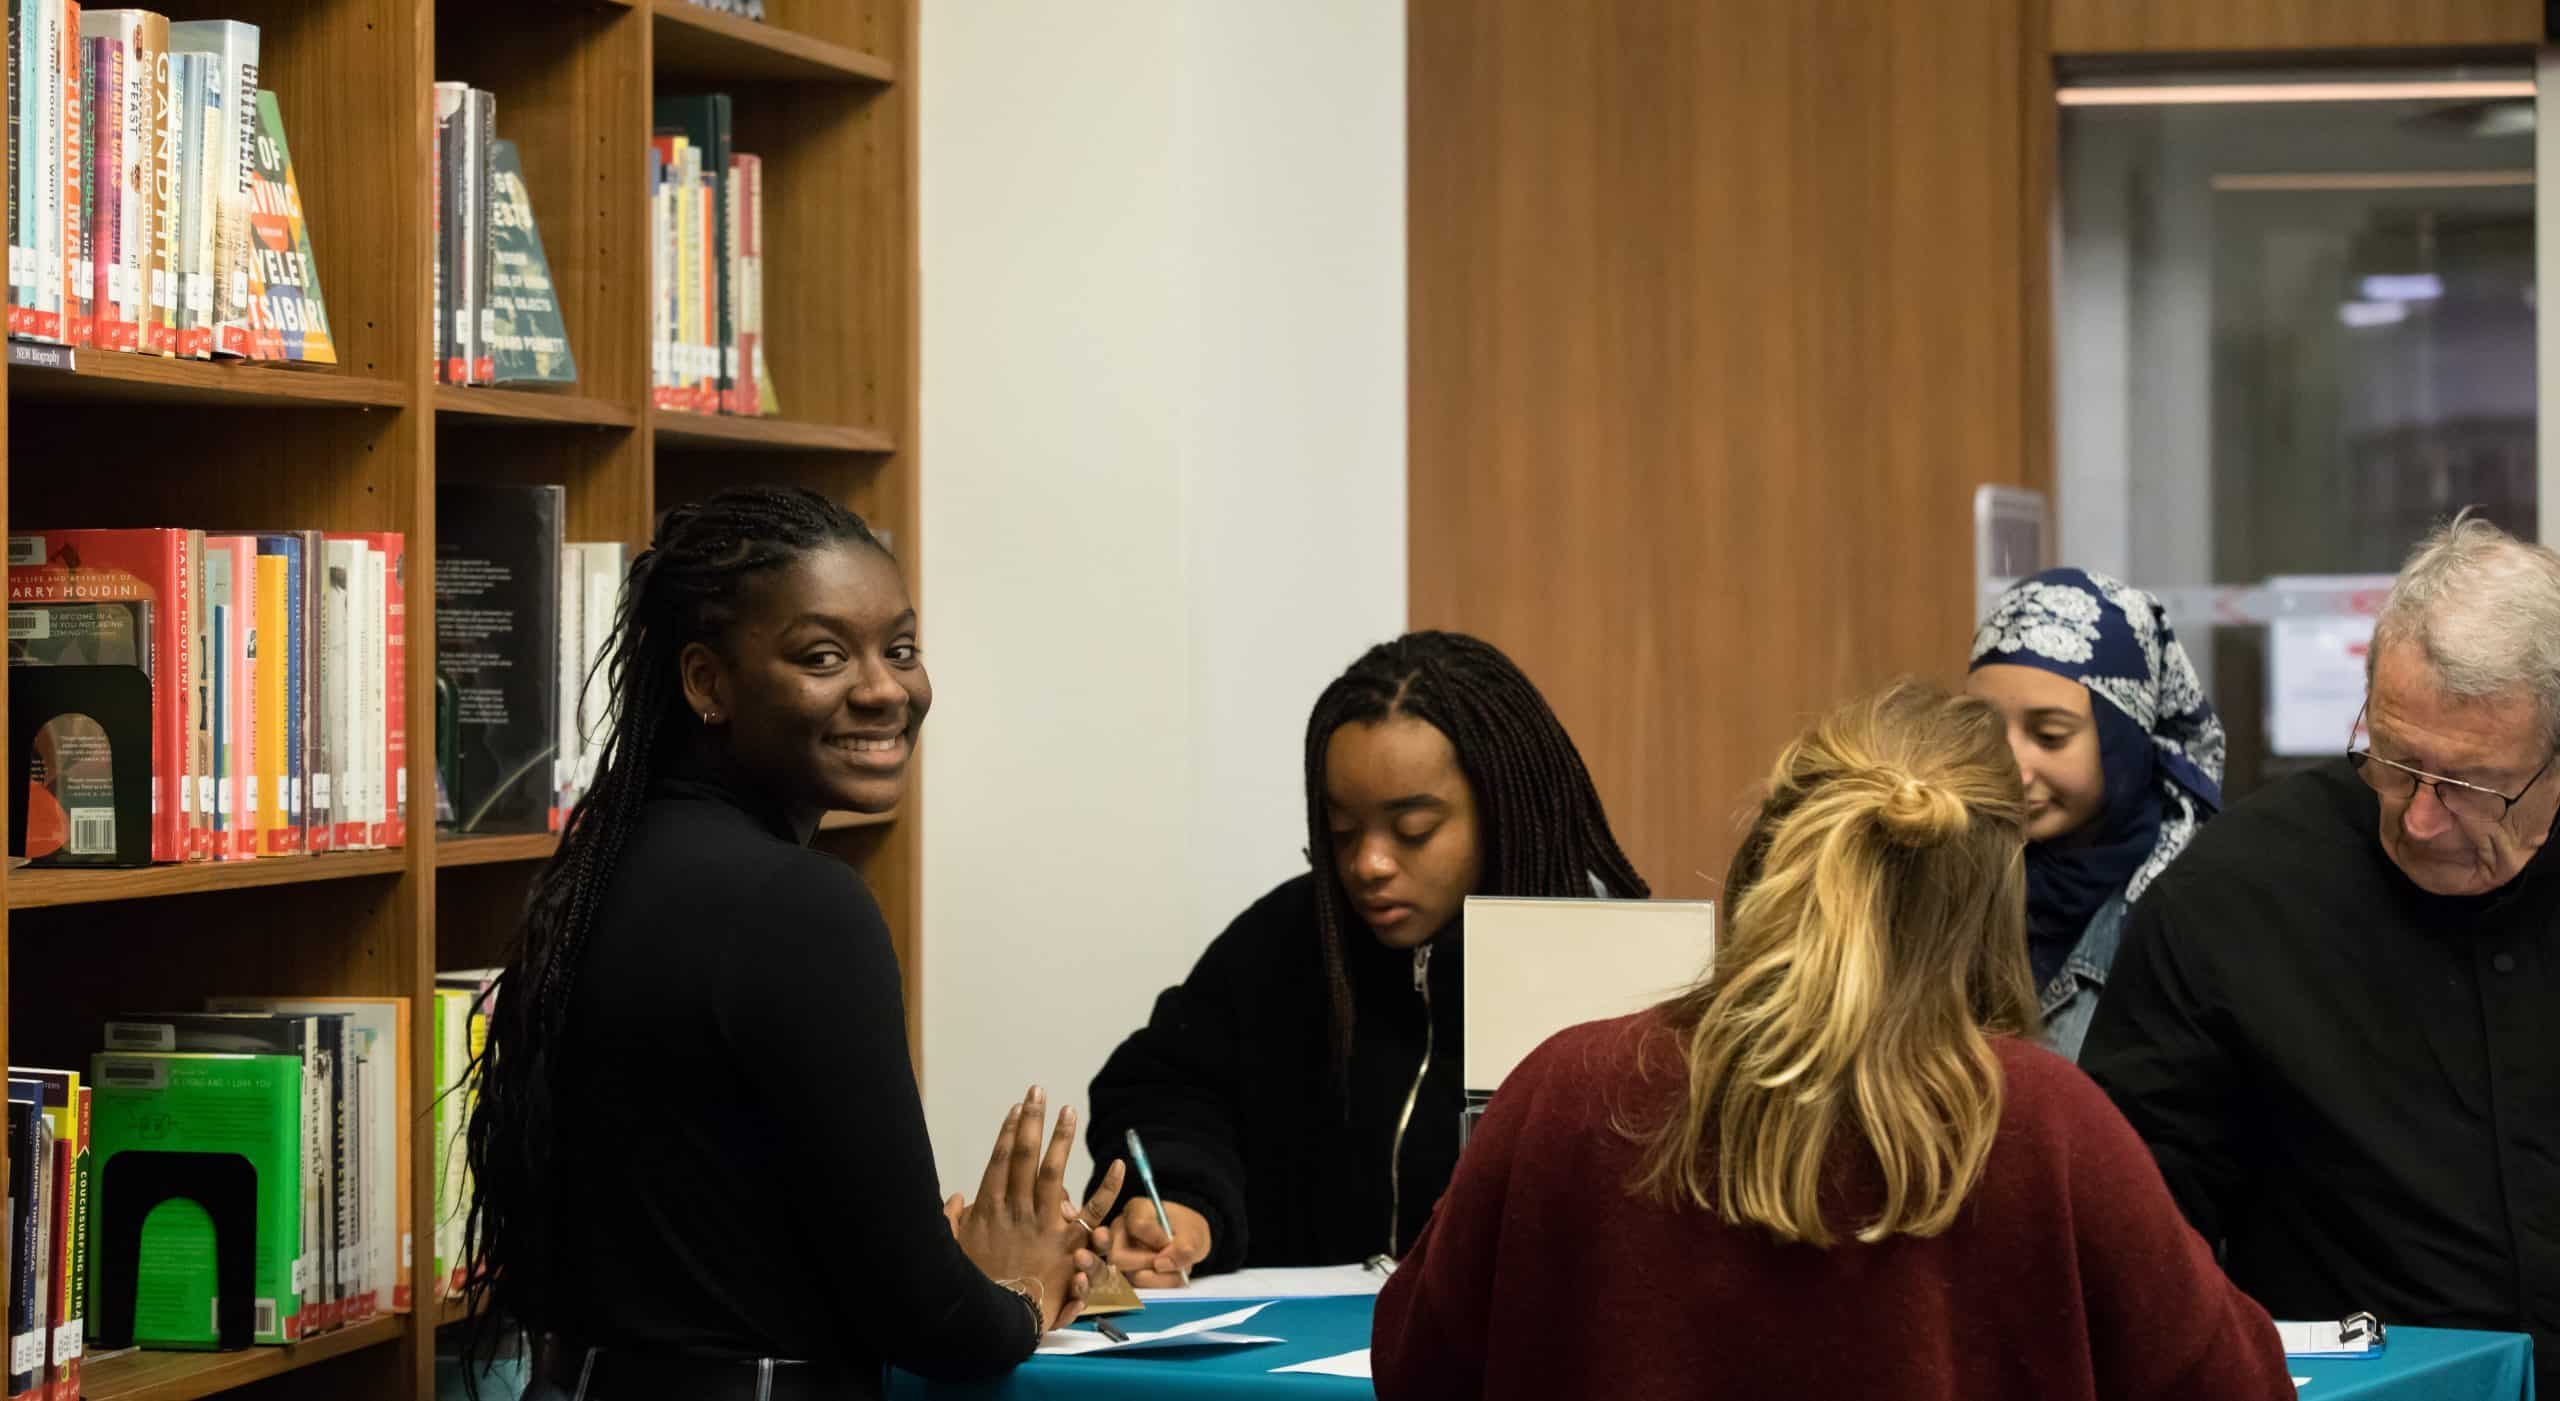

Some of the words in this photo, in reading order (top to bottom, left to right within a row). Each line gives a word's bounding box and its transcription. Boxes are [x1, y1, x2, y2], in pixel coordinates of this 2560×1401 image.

[130, 81, 139, 137] FEAST
[155, 51, 170, 259] GANDHI
[257, 134, 281, 172] OF
[248, 294, 328, 334] TSABARI
[12, 586, 55, 598] ARRY
[63, 585, 138, 598] HOUDINI
[179, 540, 188, 600] HARRY
[180, 610, 189, 692] HOUDINI
[77, 1169, 88, 1272] COUCHSURFING
